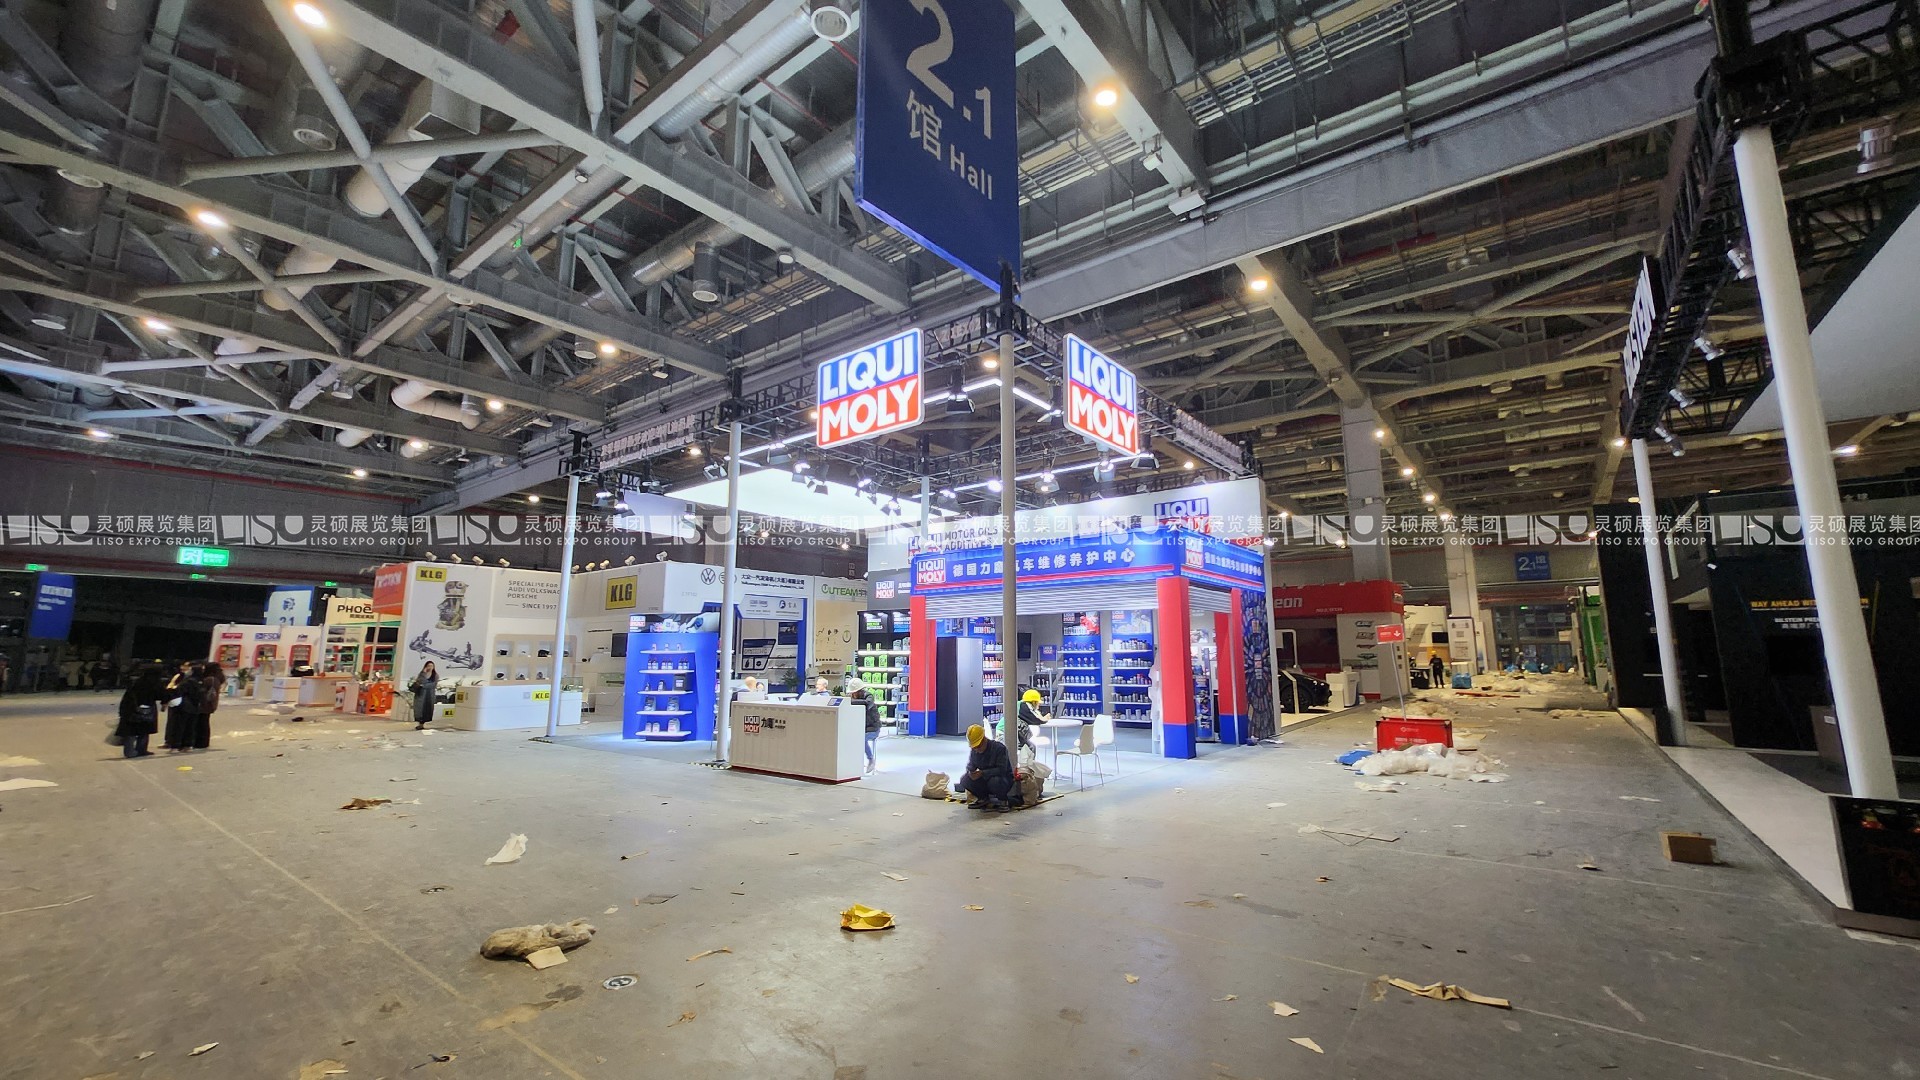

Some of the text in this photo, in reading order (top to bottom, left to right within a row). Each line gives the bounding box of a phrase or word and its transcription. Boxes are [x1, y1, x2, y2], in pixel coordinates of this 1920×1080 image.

[906, 89, 992, 200] 馆 Hall
[823, 334, 916, 401] LIQUI
[1070, 339, 1135, 409] LIQUI
[822, 379, 916, 443] MOLY
[1070, 385, 1135, 453] MOLY
[1155, 499, 1208, 519] LIQUI
[944, 529, 975, 540] MOTOR
[420, 569, 443, 579] KLG
[919, 559, 944, 571] LIQUI
[919, 571, 945, 583] MOLY
[610, 582, 633, 602] KLG
[744, 716, 759, 724] LIQUI
[744, 724, 759, 732] MOLY
